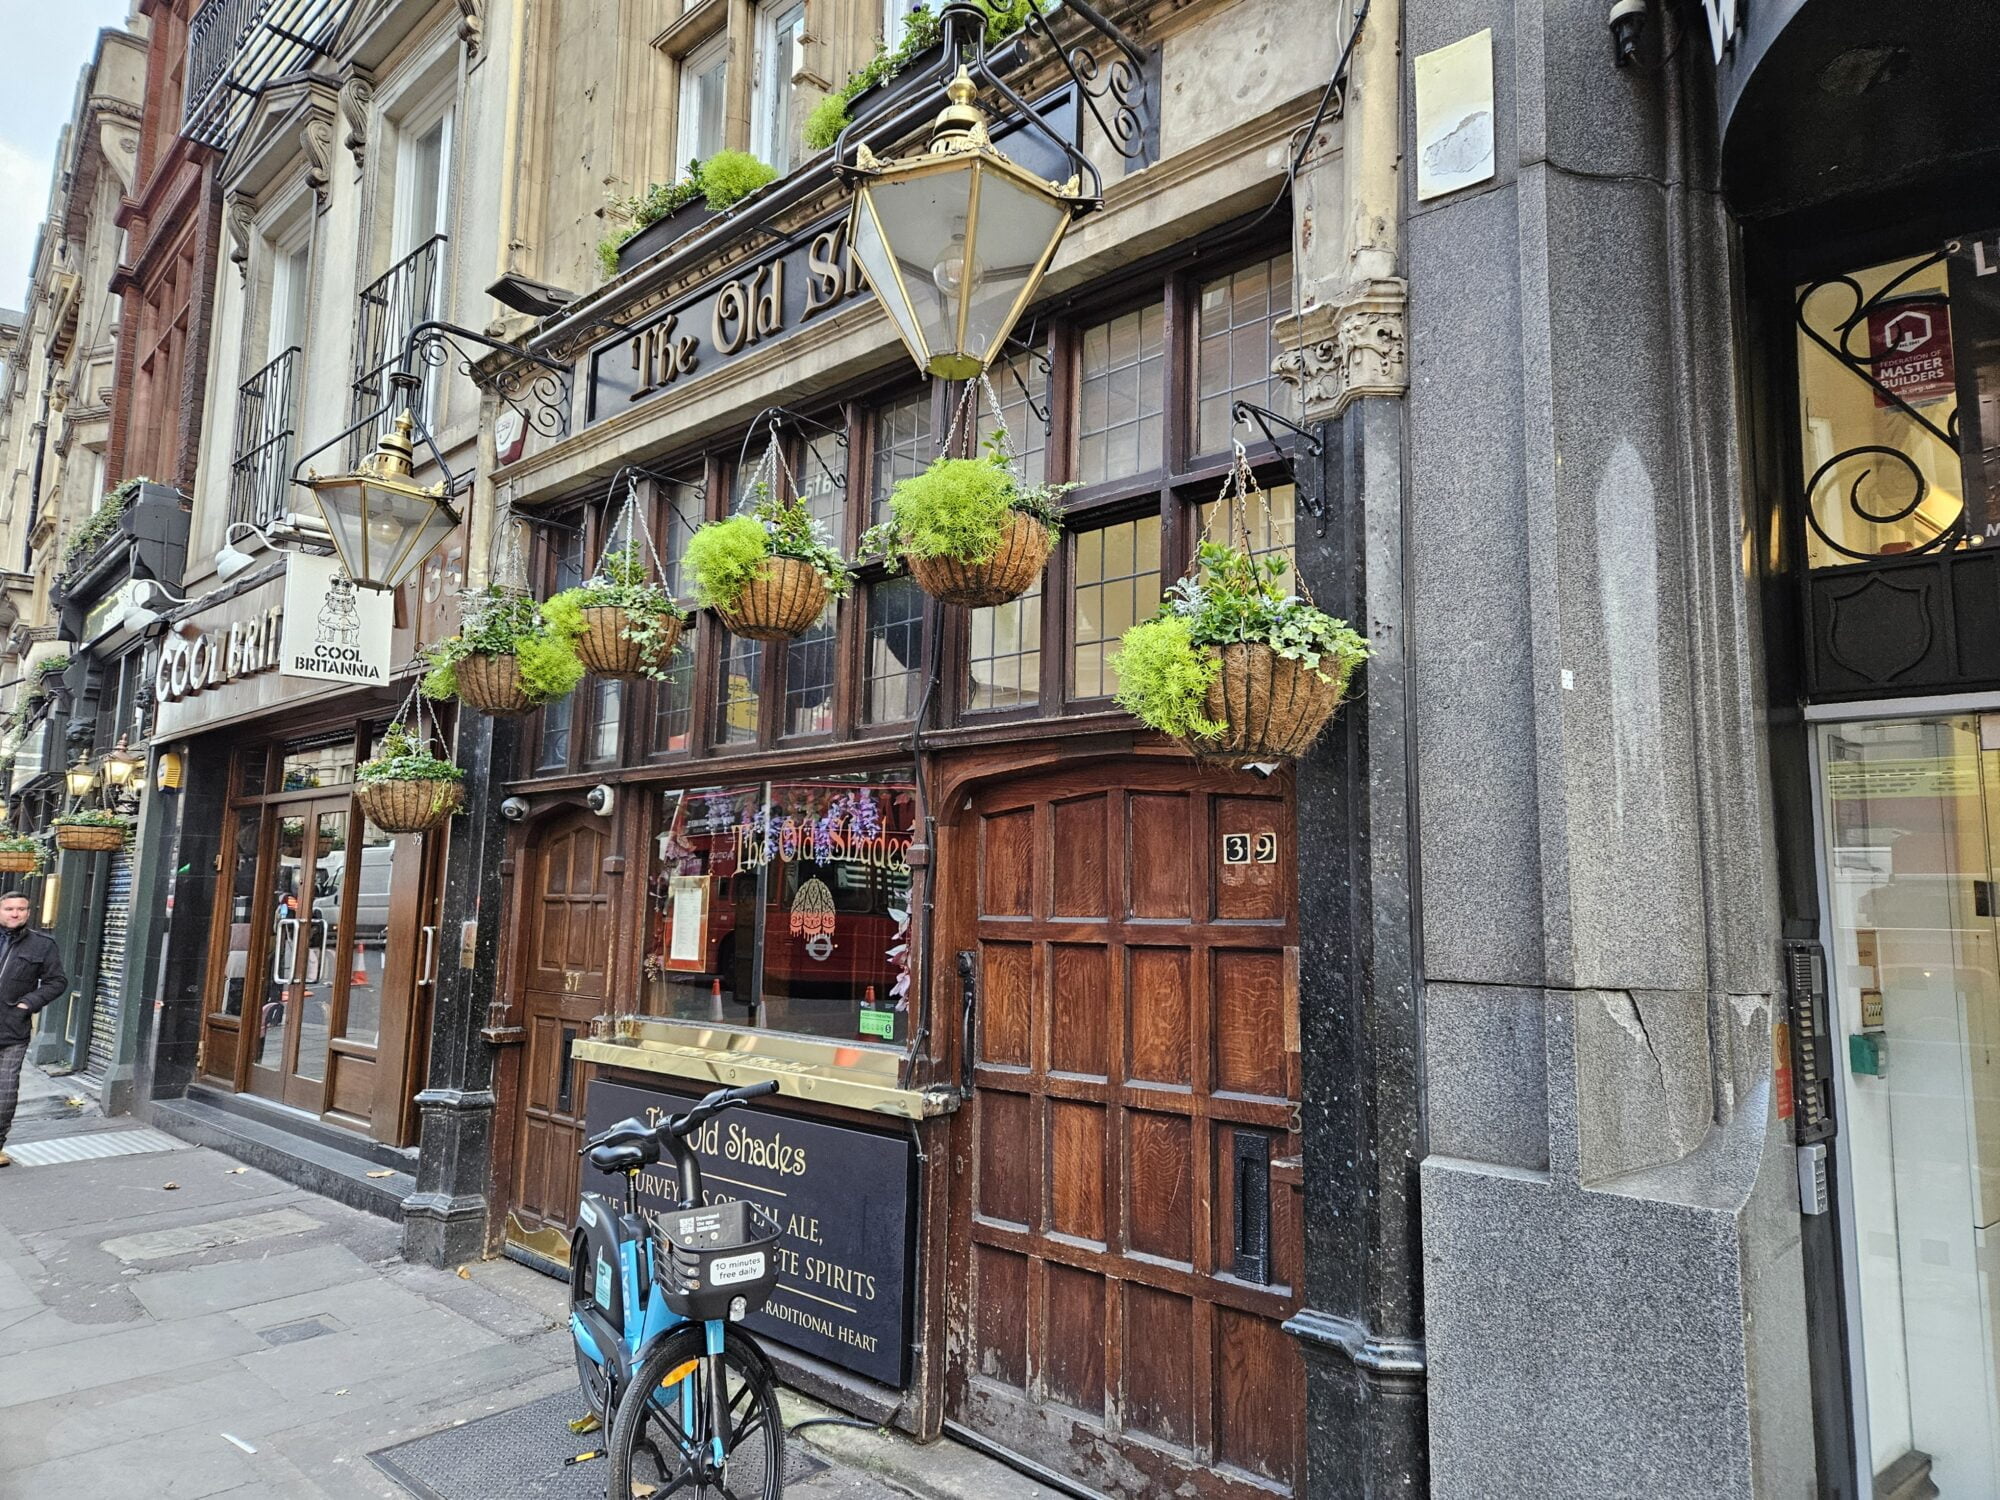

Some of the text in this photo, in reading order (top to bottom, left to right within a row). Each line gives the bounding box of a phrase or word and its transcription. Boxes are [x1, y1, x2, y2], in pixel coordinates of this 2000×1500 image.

[629, 314, 698, 402] The
[711, 258, 784, 355] Old
[1930, 349, 1941, 357] OF
[1880, 357, 1943, 379] MASTER
[1880, 368, 1945, 388] BUILDERS
[424, 546, 462, 604] 35
[156, 627, 227, 702] COOL
[314, 644, 362, 662] COOL
[294, 656, 380, 679] BRITANNIA
[412, 832, 423, 846] 35
[731, 824, 769, 879] The
[779, 818, 815, 863] Old
[1228, 837, 1272, 861] 39
[565, 971, 580, 992] 37
[724, 1122, 806, 1177] Shades
[787, 1213, 824, 1247] ALE,
[715, 1257, 761, 1271] 10 minutes
[719, 1266, 758, 1280] free daily
[805, 1256, 876, 1302] SPIRITS
[761, 1299, 878, 1353] RADITIONAL HEART
